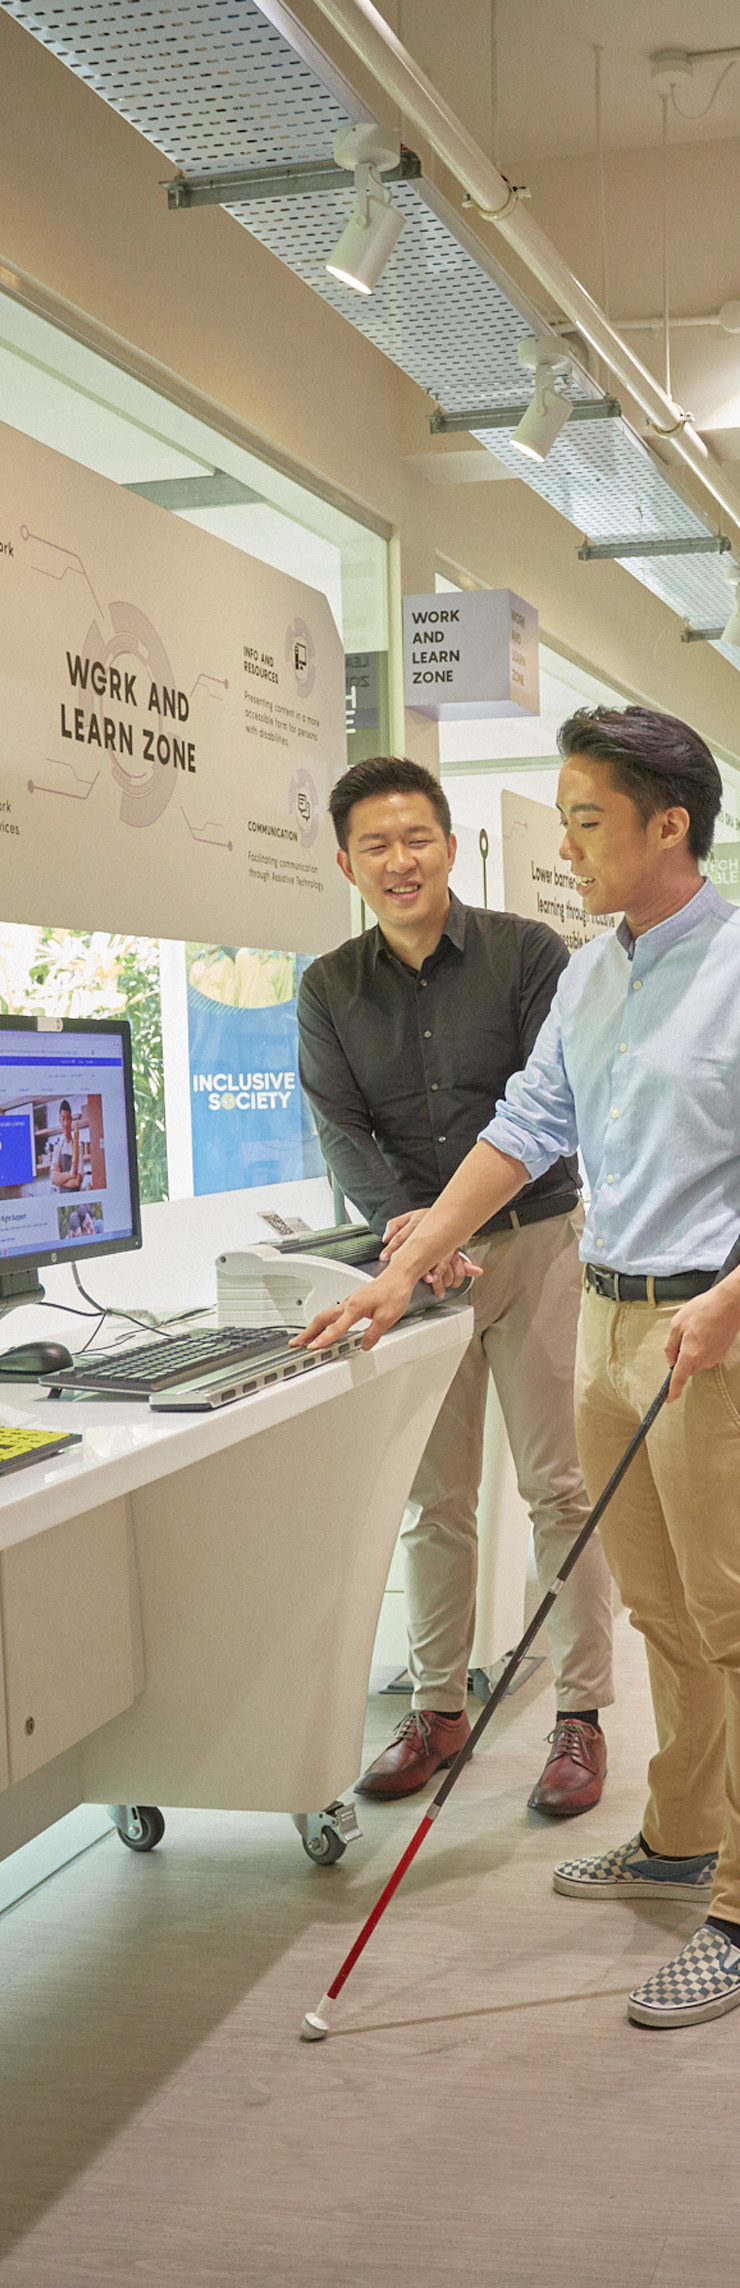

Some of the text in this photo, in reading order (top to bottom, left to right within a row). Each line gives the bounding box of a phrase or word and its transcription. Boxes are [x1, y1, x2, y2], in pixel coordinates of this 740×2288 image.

[412, 610, 460, 624] WORK
[412, 631, 445, 644] AND
[243, 645, 275, 668] INFO AND
[412, 650, 460, 664] LEARN
[243, 660, 279, 684] RESOURCES
[412, 670, 453, 684] ZONE
[66, 651, 189, 722] WORK AND
[244, 690, 273, 713] Presenting
[274, 704, 295, 717] content
[307, 716, 320, 728] more
[245, 708, 319, 742] accessible form for persons
[245, 725, 258, 736] with
[61, 703, 196, 773] LEARN ZONE
[247, 820, 298, 842] COMMUNICATION
[248, 850, 318, 874] Facilitating communication
[531, 860, 553, 885] Lower
[248, 866, 271, 883] through
[272, 871, 295, 885] Assistive
[536, 891, 565, 924] learning
[193, 1072, 296, 1092] INCLUSIVE
[208, 1091, 292, 1111] SOCIETY
